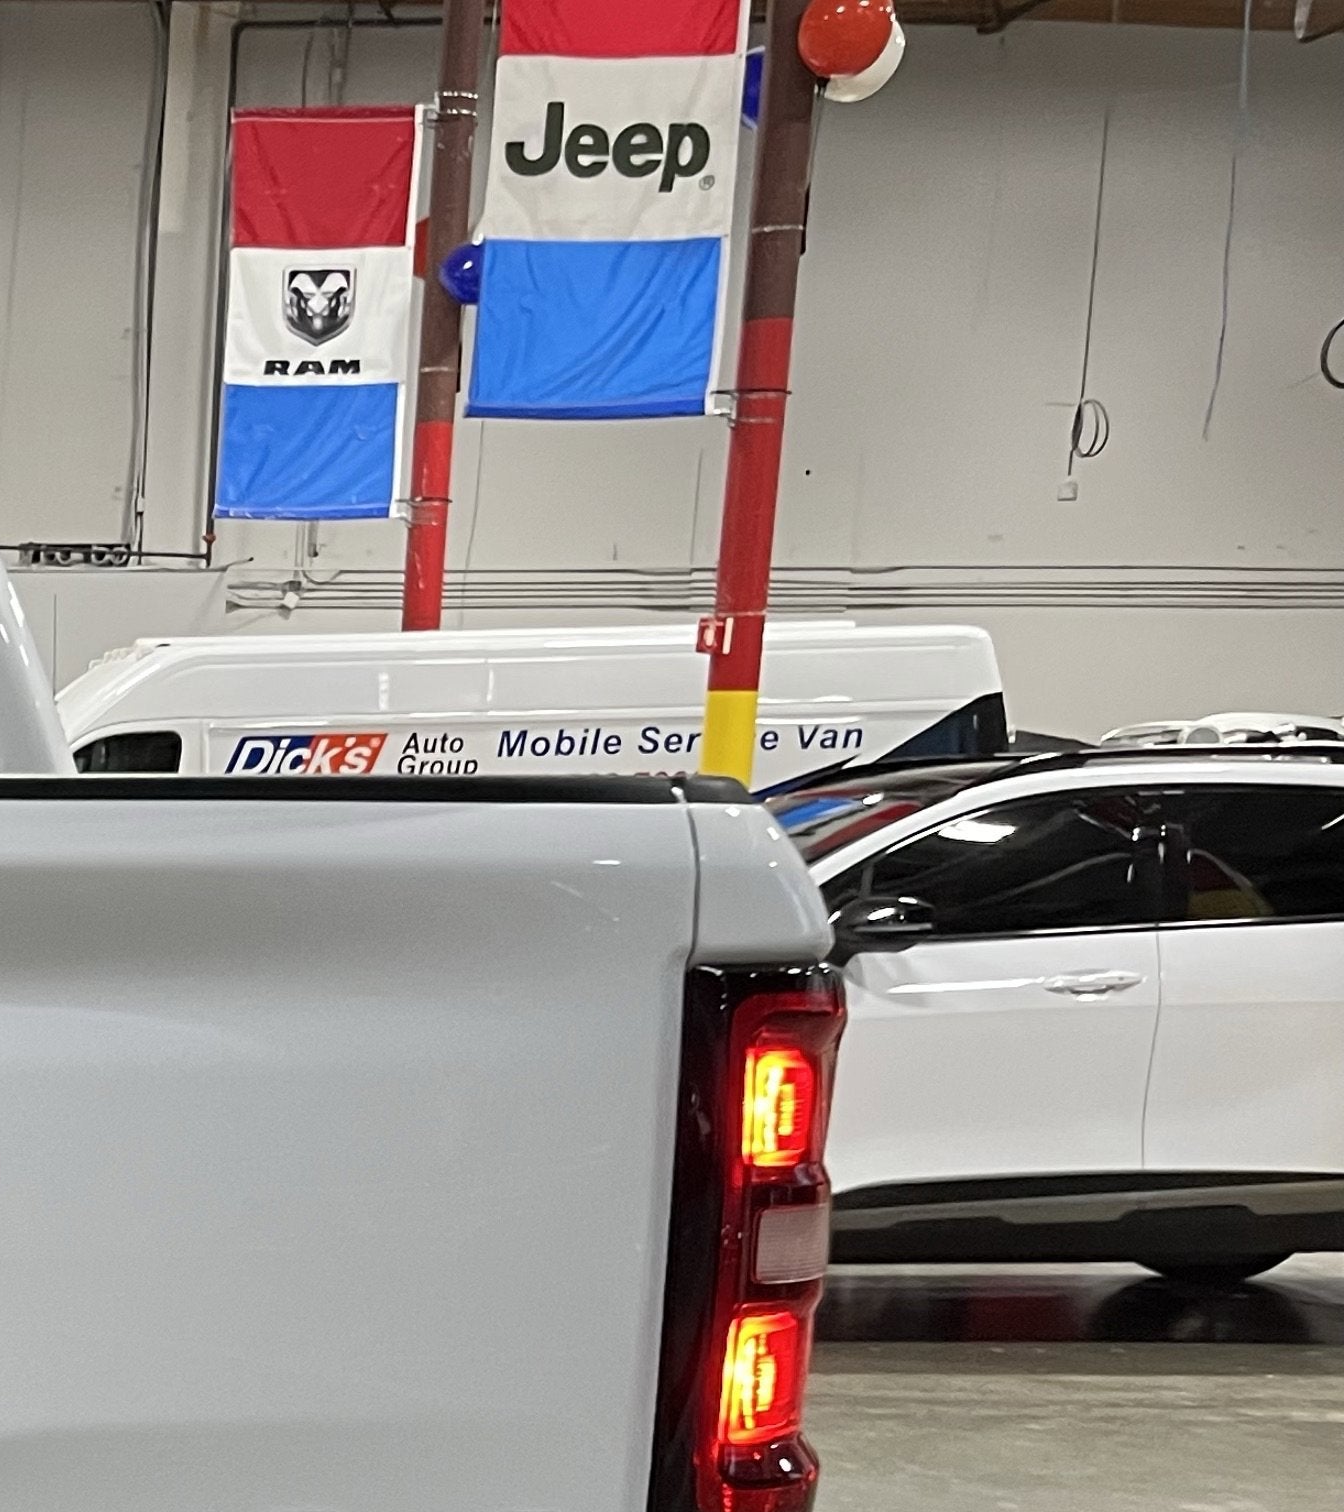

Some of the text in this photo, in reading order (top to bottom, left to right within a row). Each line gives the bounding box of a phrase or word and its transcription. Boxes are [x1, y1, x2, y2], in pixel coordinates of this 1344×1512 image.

[504, 101, 711, 192] Jeep
[263, 359, 361, 376] RAM
[402, 732, 464, 755] Auto
[497, 725, 863, 758] Mobile Sere Van
[397, 755, 479, 775] Group
